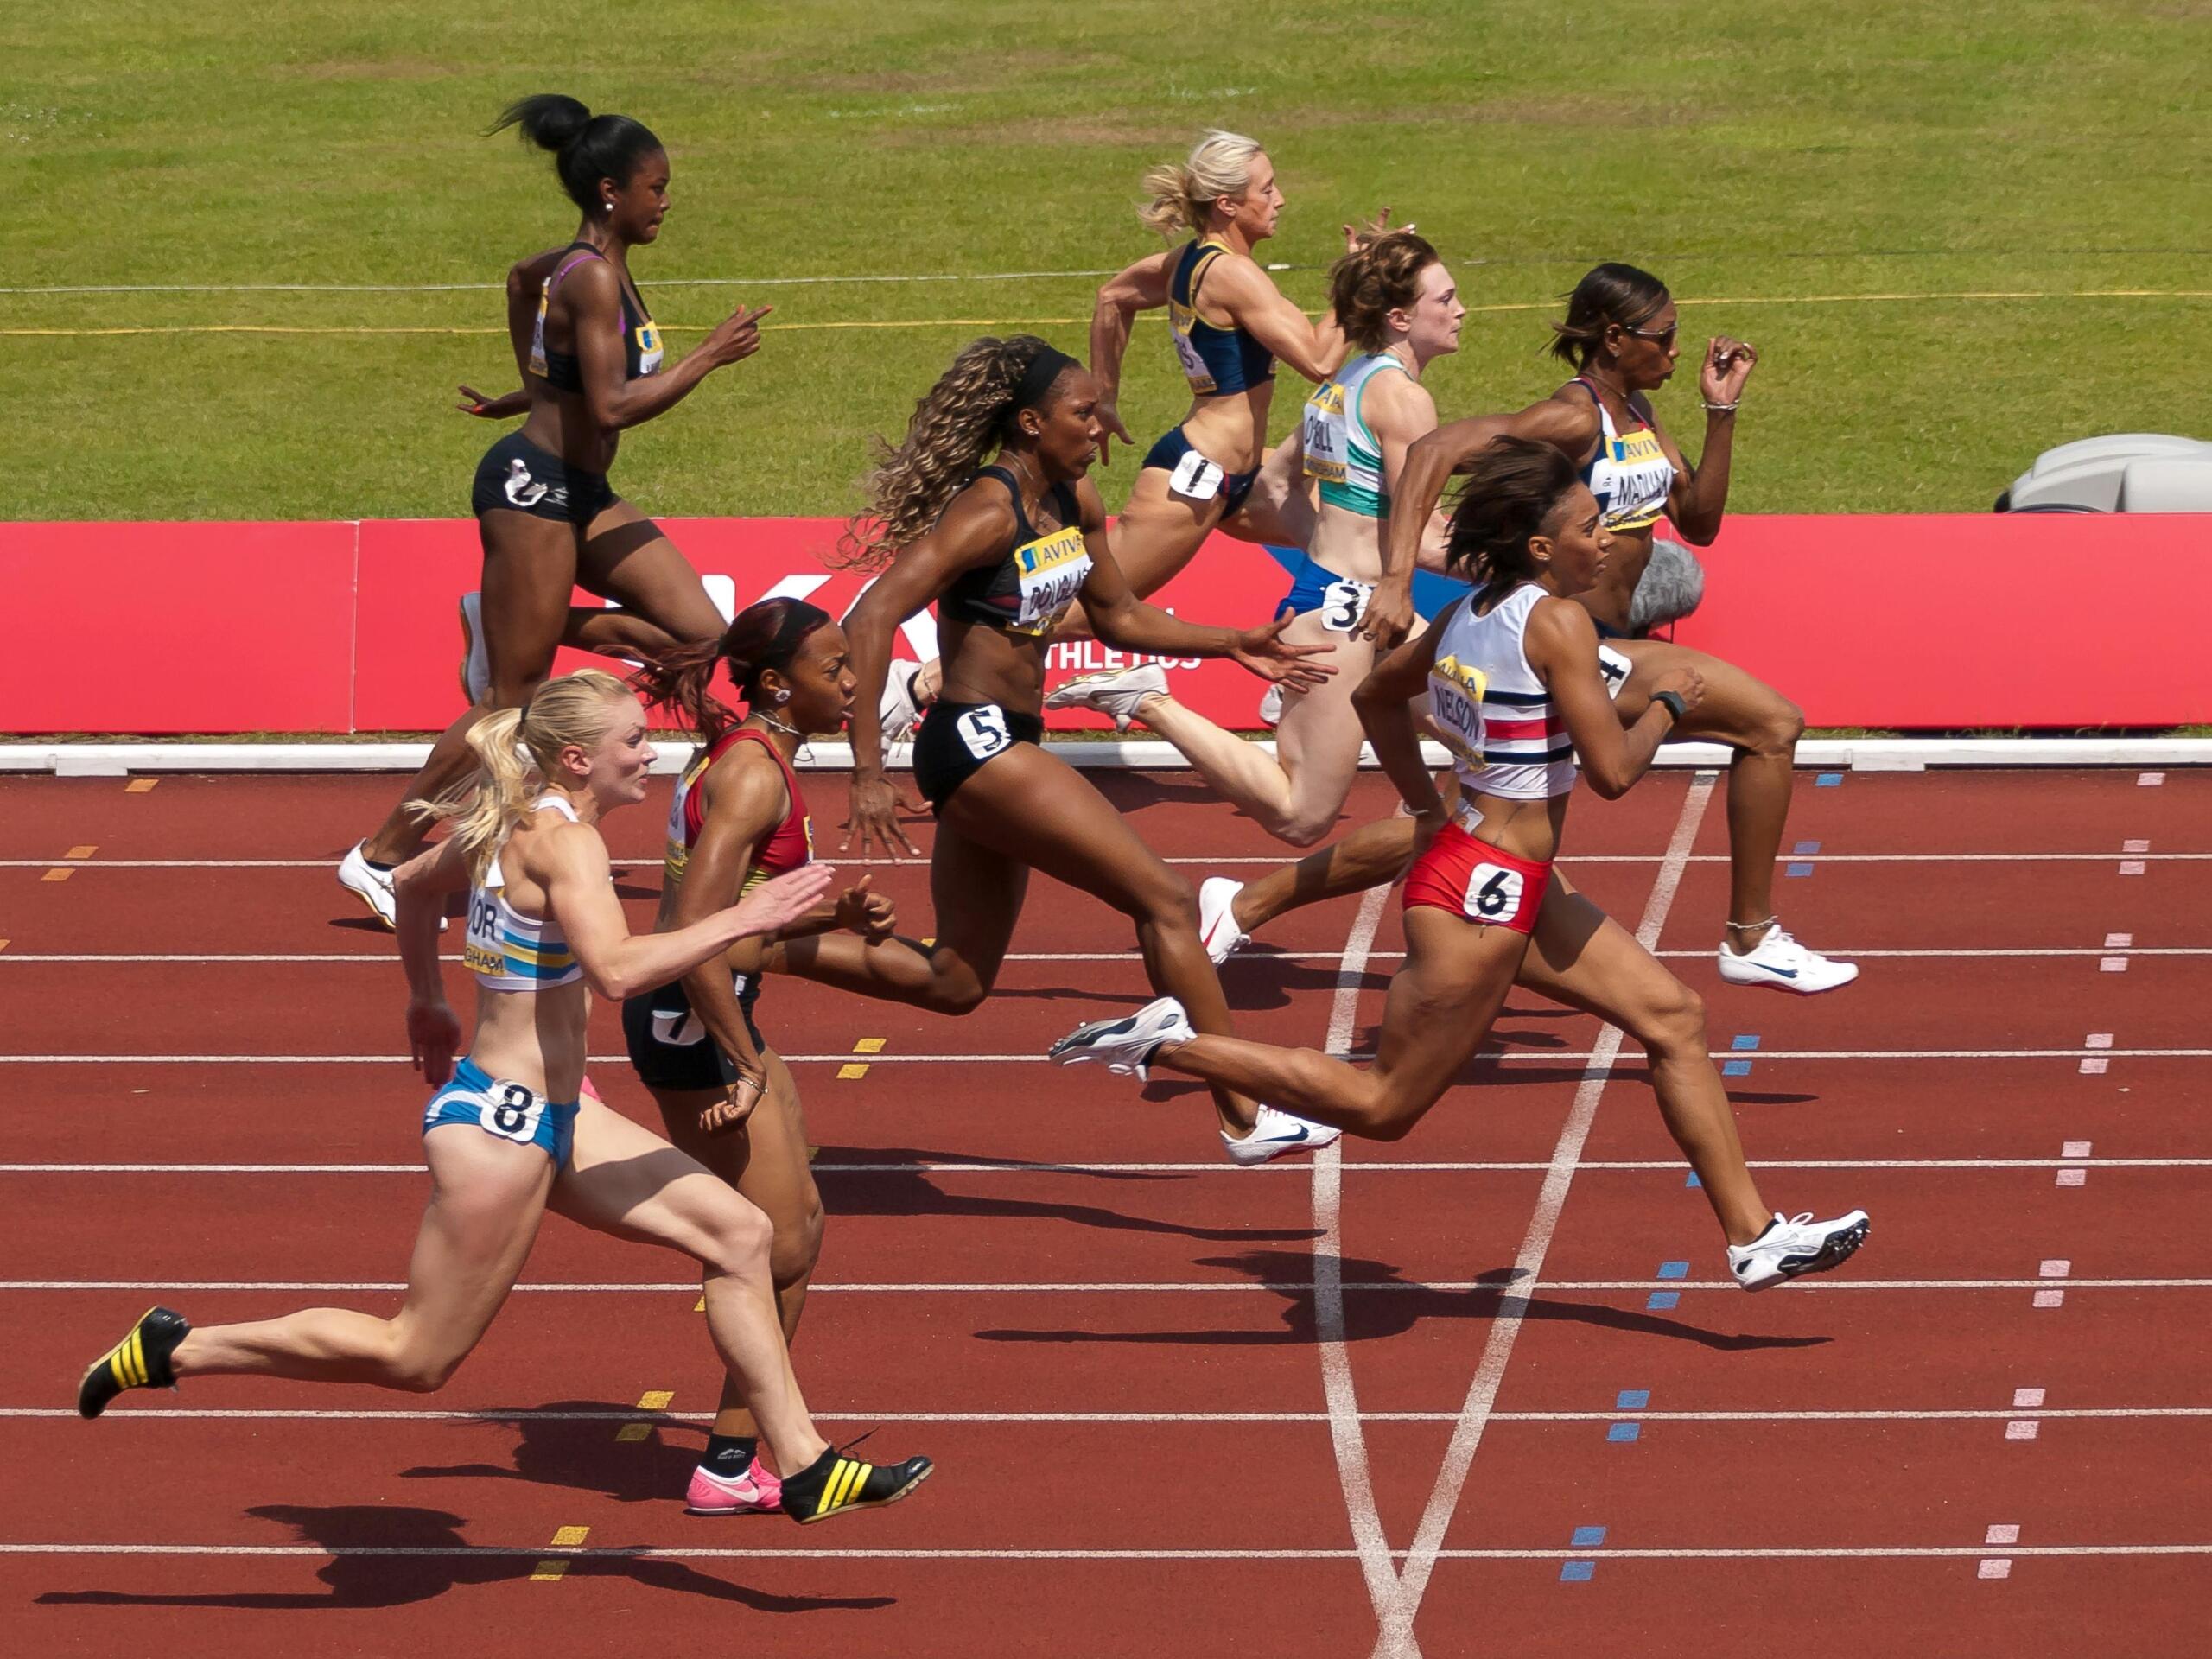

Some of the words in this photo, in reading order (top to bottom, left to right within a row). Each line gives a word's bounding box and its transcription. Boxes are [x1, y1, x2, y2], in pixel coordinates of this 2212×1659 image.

[1332, 586, 1361, 628] 3
[968, 709, 1003, 753] 5
[1433, 684, 1481, 741] NELSON
[1476, 869, 1510, 916] 6
[493, 1084, 534, 1134] 8
